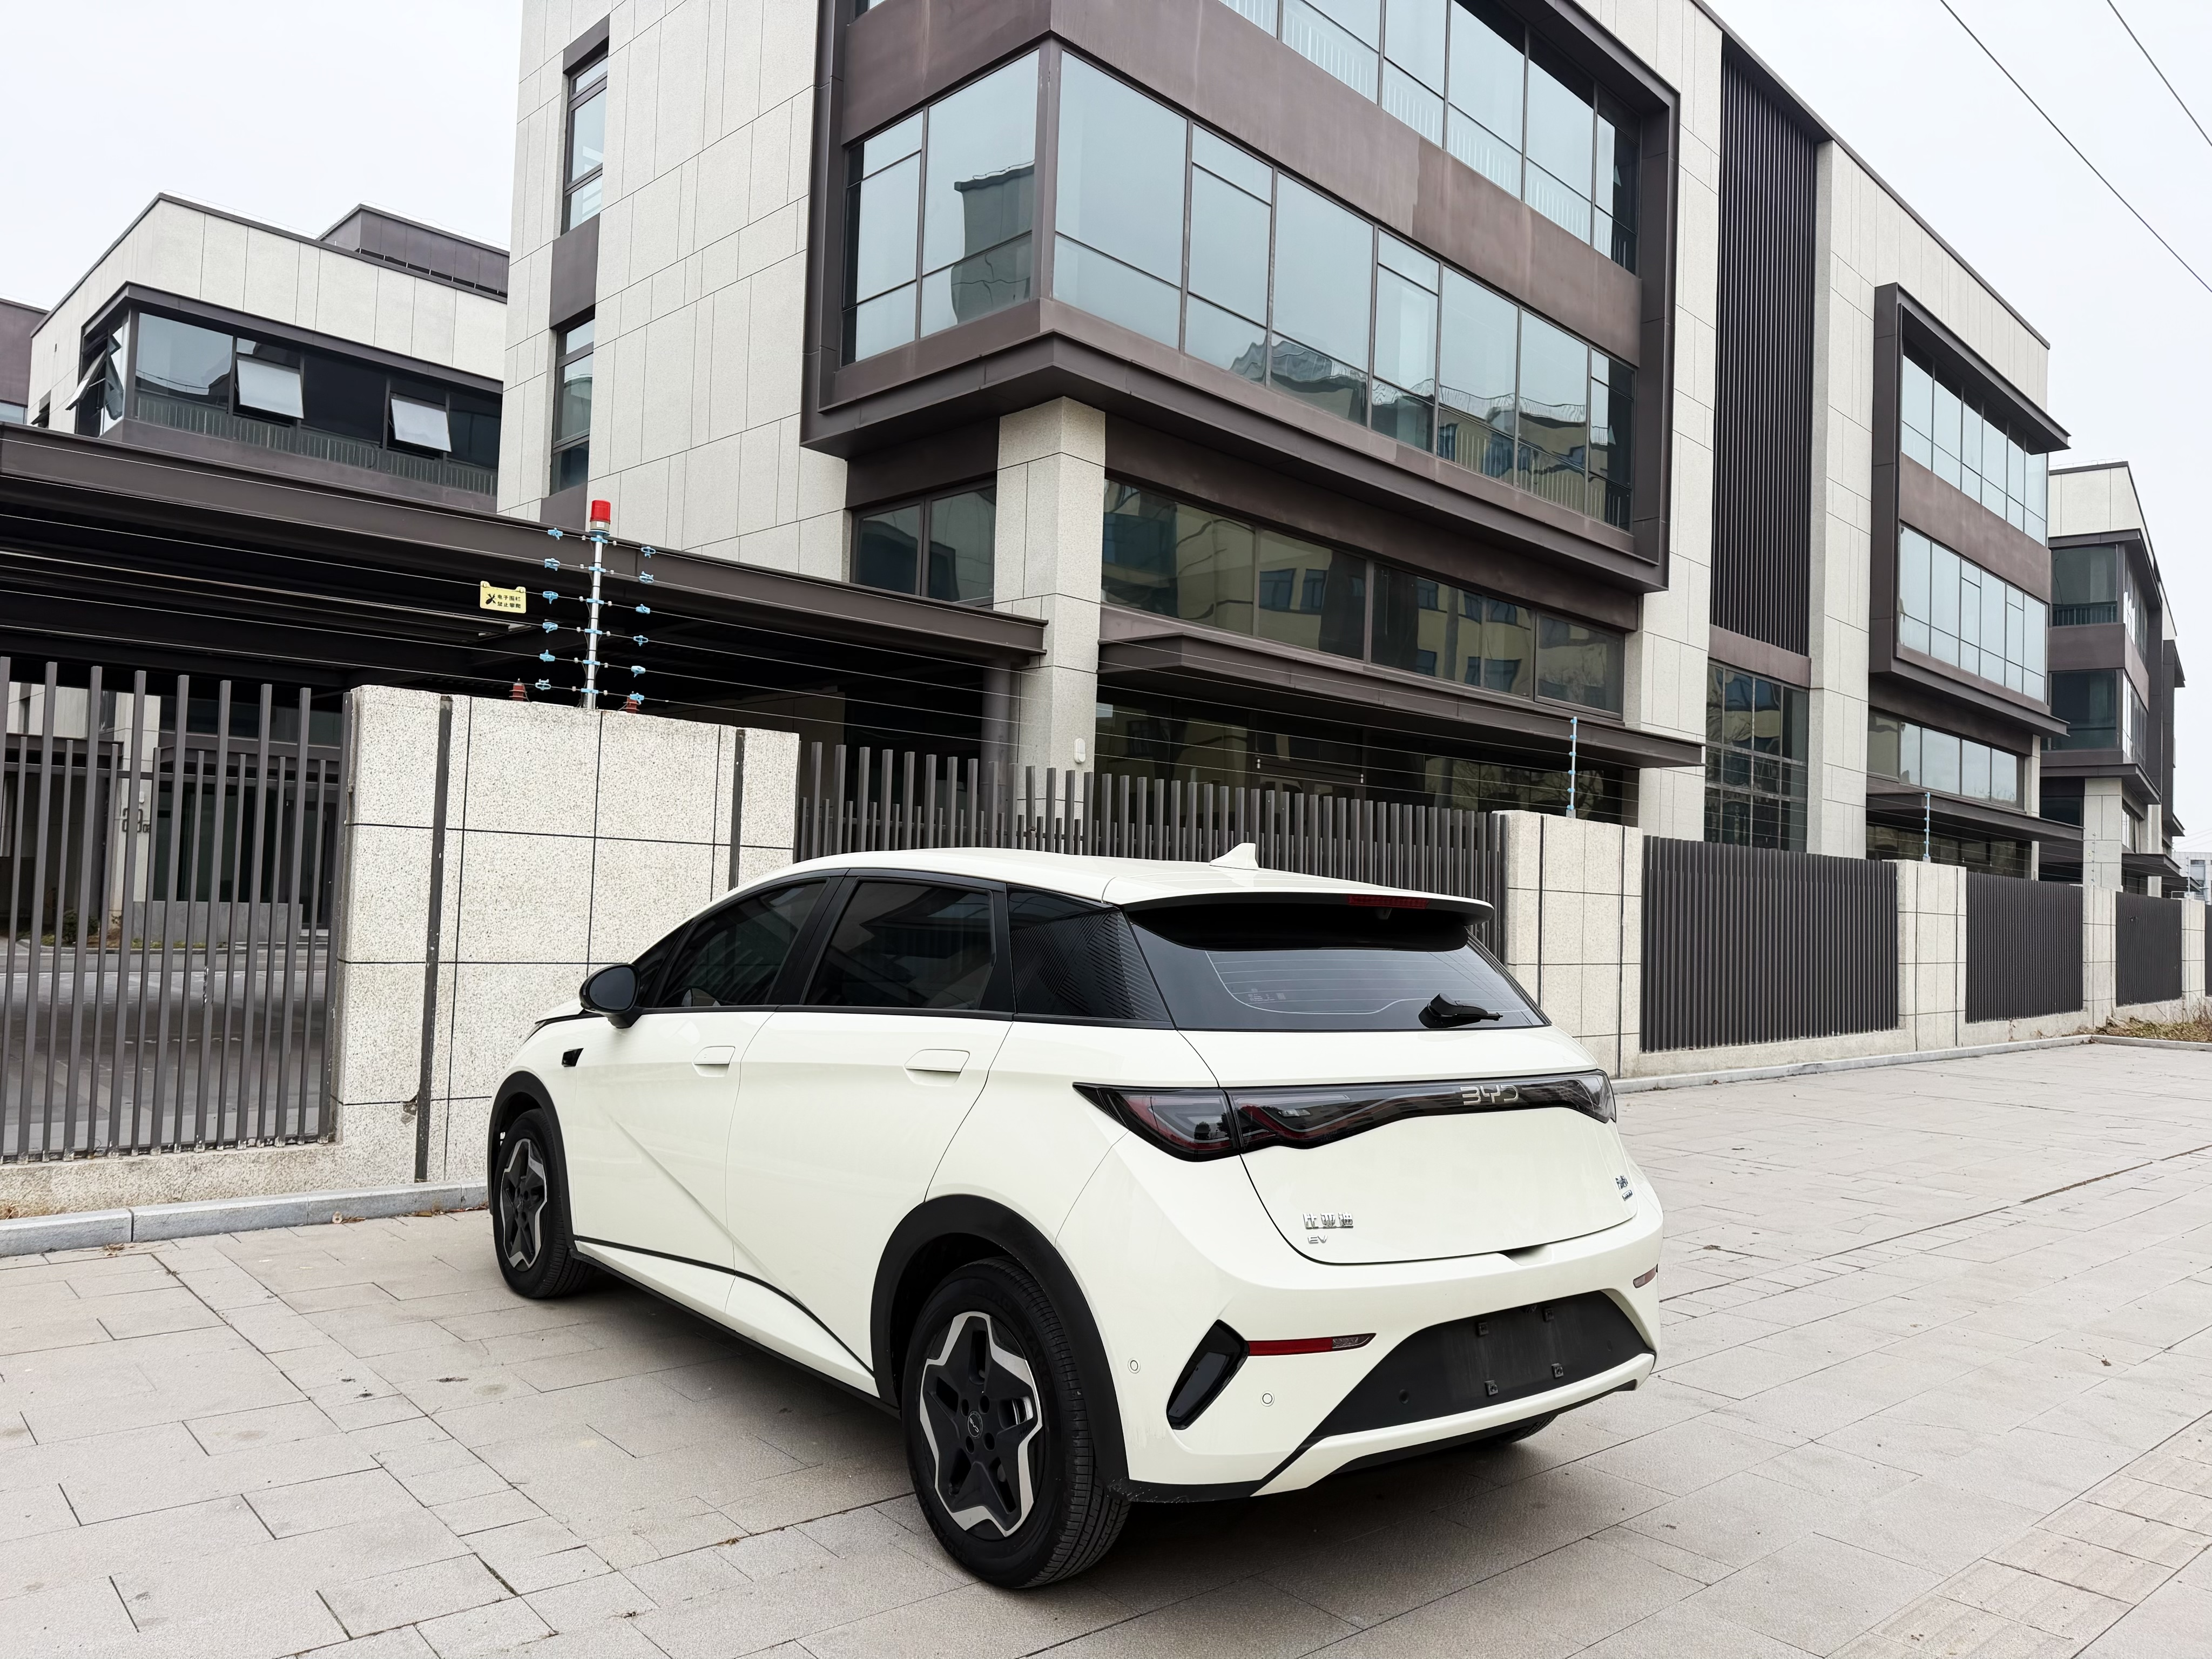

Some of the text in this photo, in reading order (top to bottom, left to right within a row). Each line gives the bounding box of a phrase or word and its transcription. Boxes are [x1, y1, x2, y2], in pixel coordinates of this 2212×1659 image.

[1460, 1084, 1519, 1105] BYD
[1303, 1212, 1354, 1229] 比亚迪
[1307, 1235, 1328, 1244] EV
